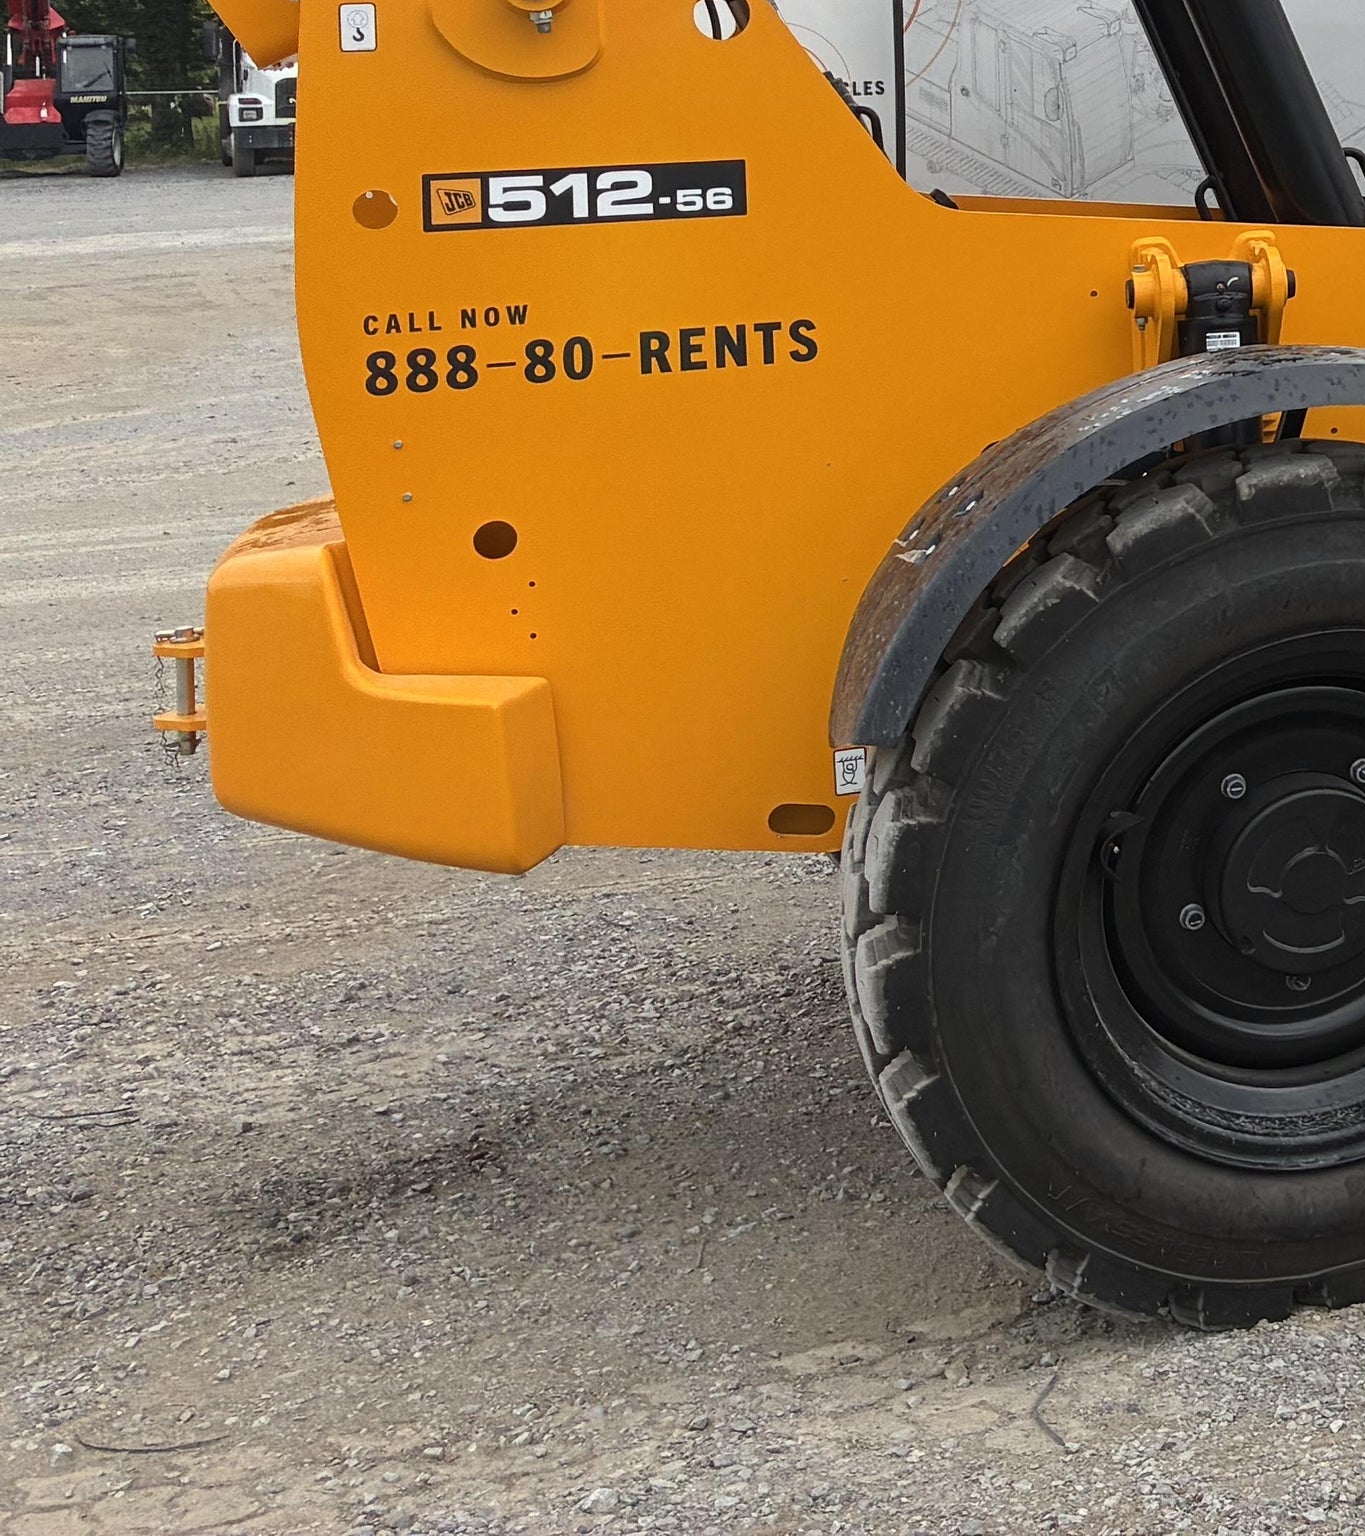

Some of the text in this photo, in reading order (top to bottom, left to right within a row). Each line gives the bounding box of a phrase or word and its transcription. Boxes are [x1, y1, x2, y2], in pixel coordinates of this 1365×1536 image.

[440, 192, 475, 214] JCB
[363, 304, 529, 336] CALL NOW
